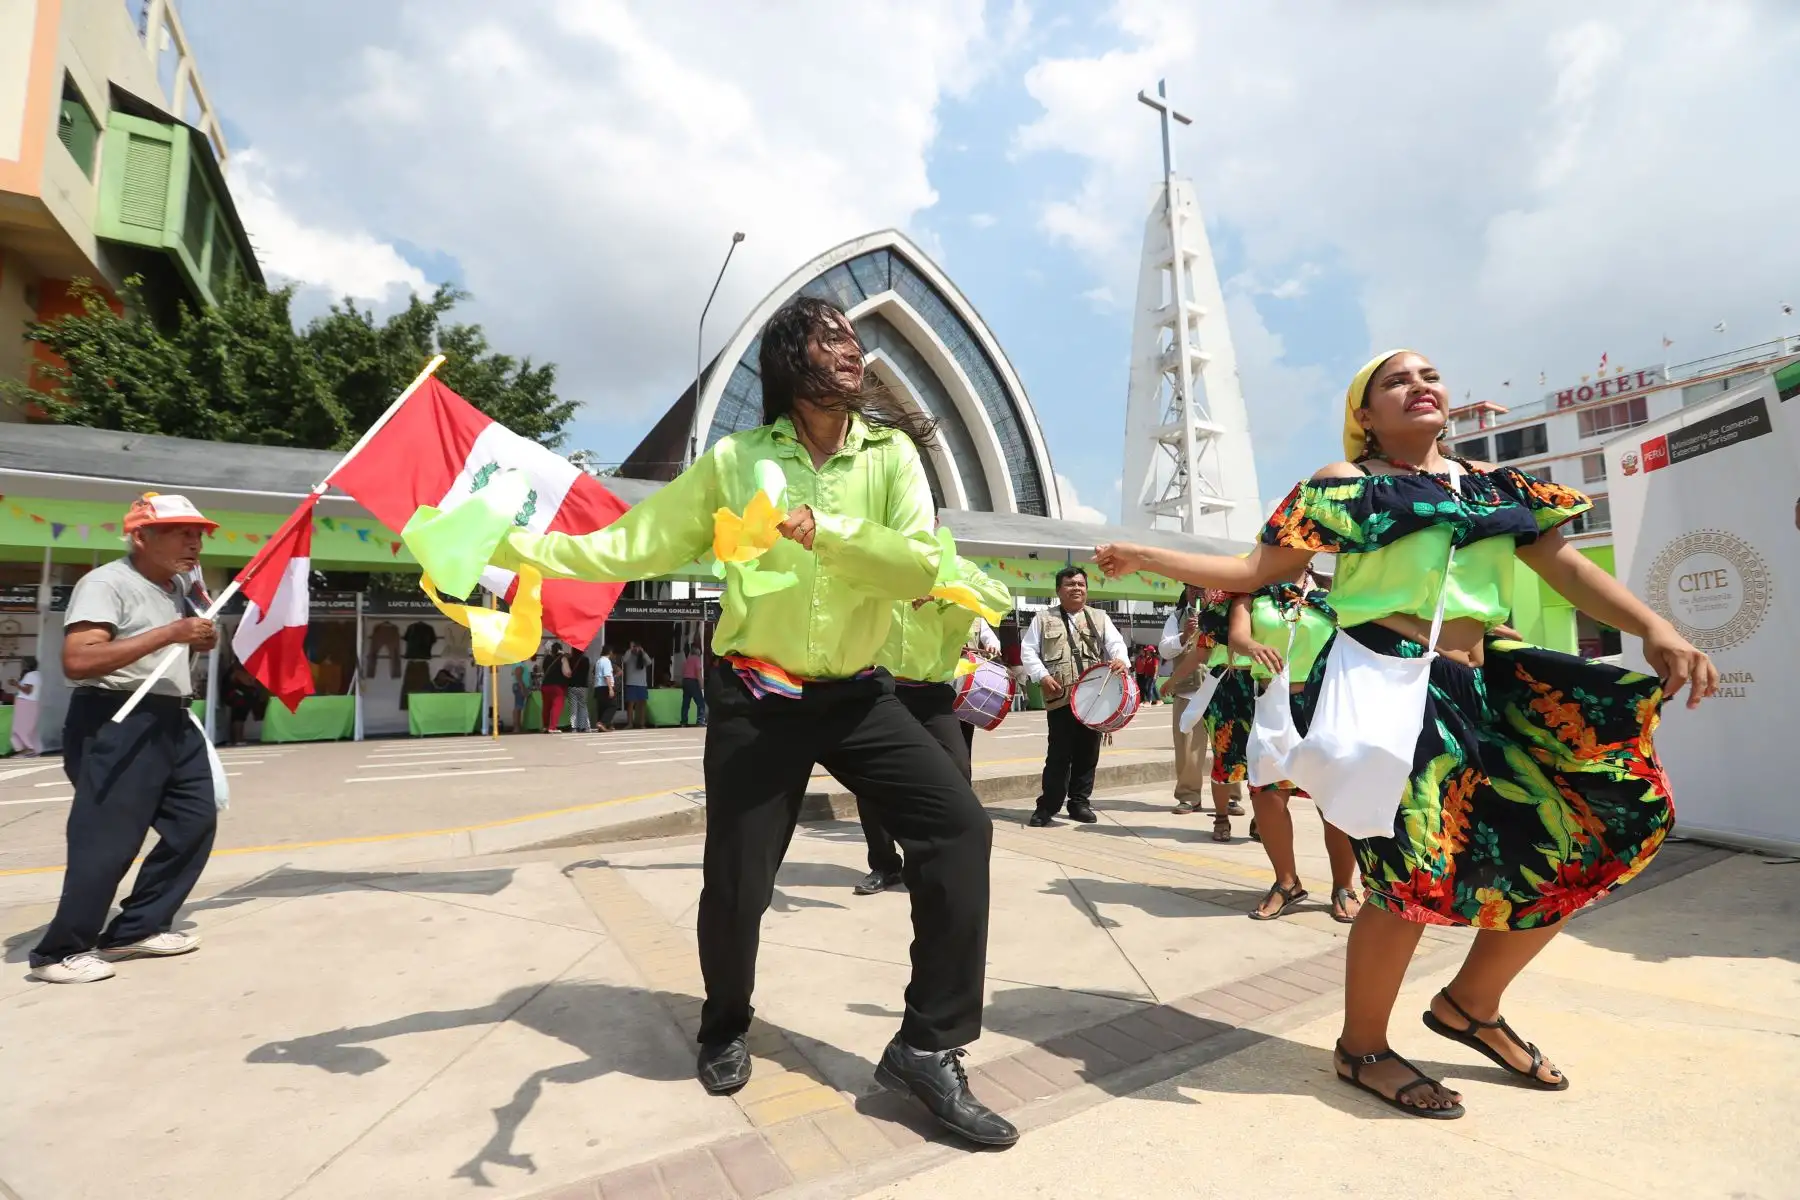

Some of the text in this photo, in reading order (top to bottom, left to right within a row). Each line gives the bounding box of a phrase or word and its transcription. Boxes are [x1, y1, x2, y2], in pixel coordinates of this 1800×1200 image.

[1555, 370, 1654, 408] HOTEL
[1671, 415, 1760, 450] Ministerio de Comercio
[1707, 431, 1739, 446] Turismo
[1643, 445, 1666, 462] PERÚ
[1678, 569, 1728, 592] CITE
